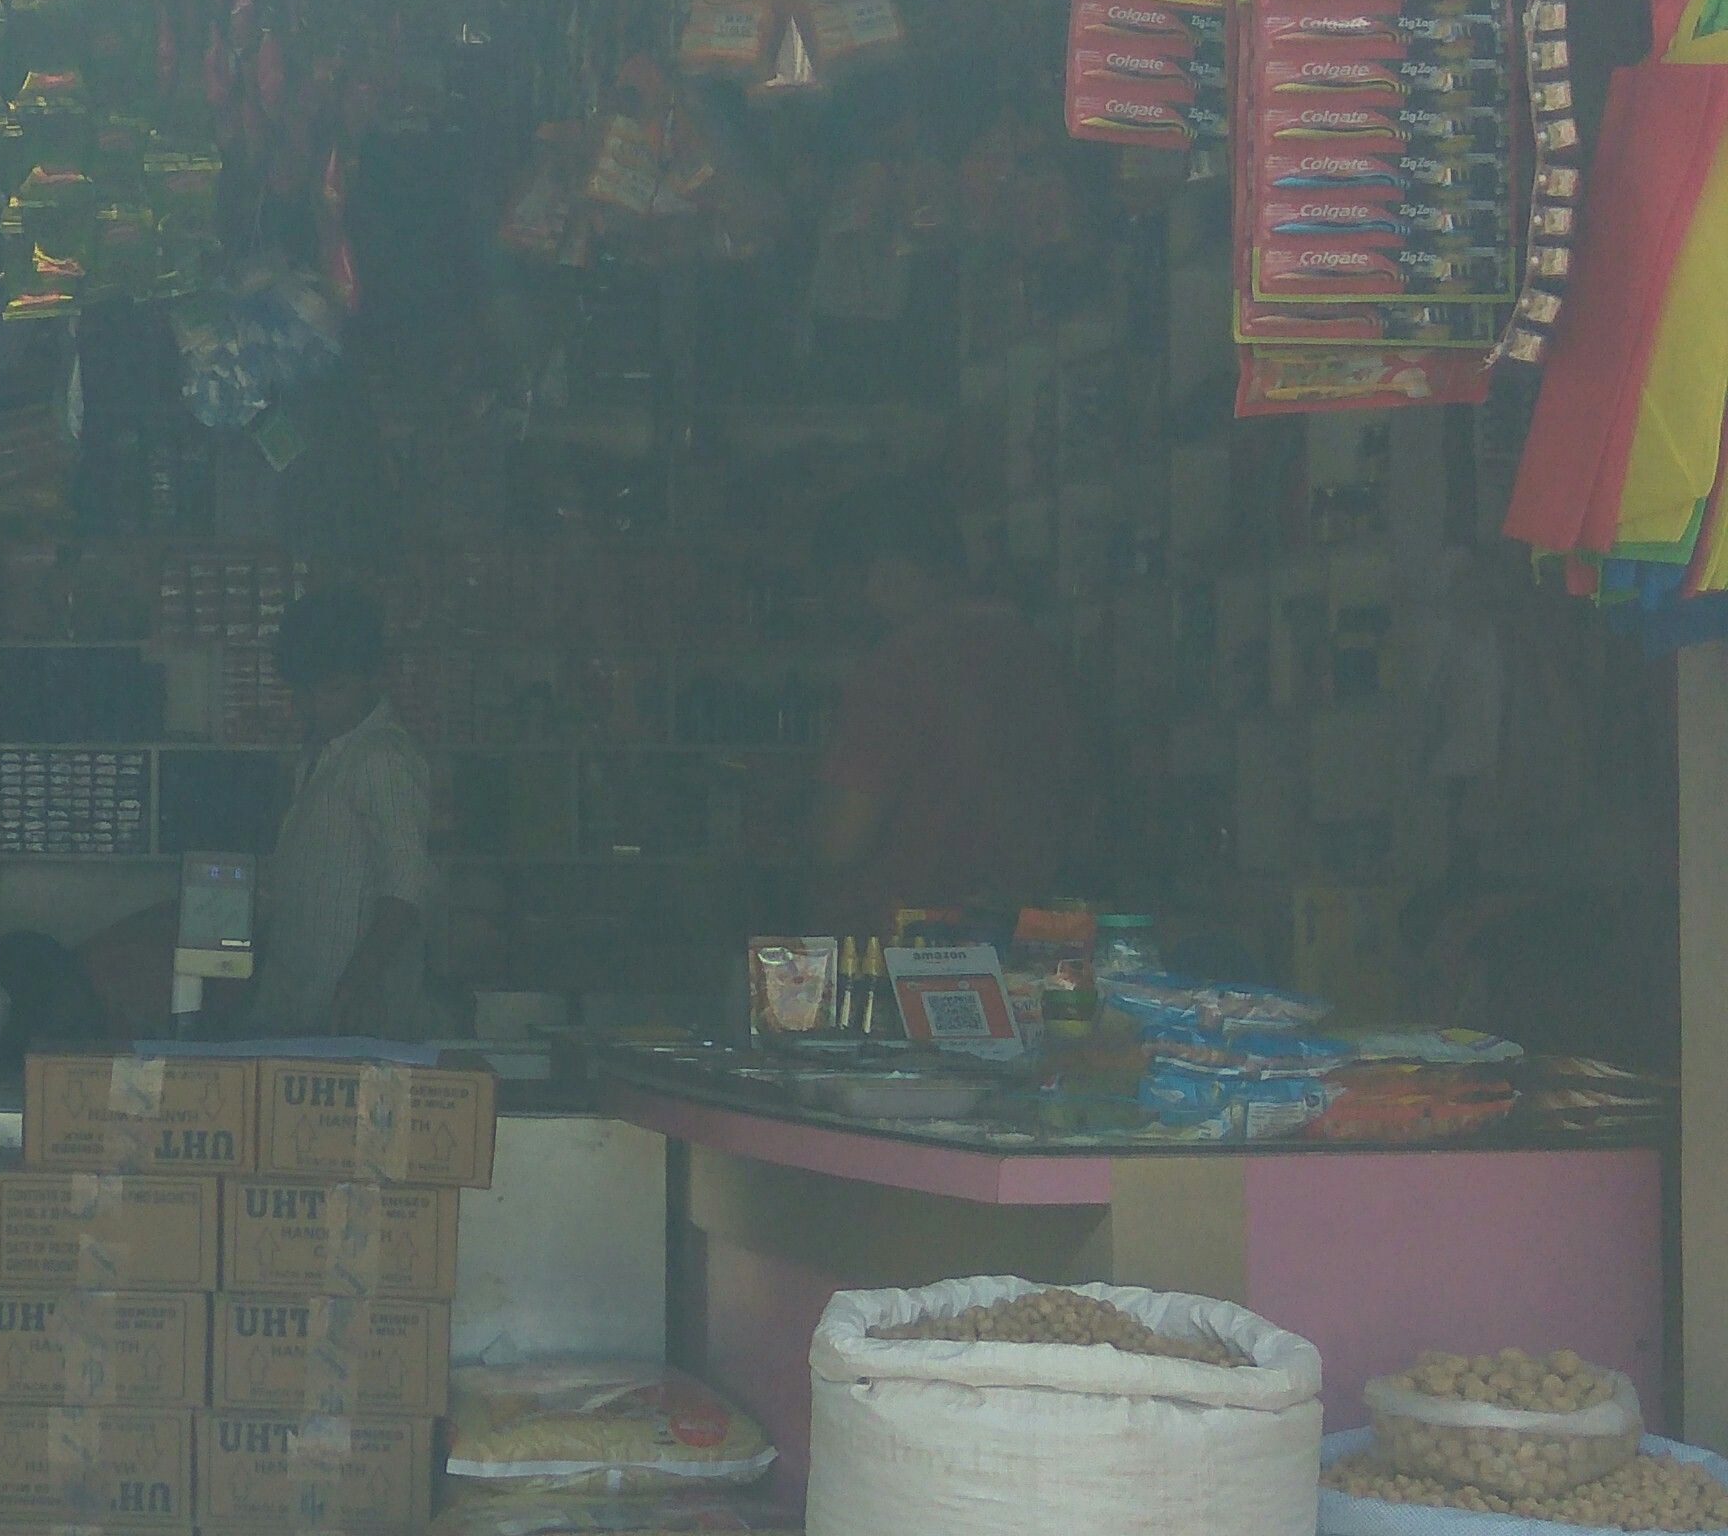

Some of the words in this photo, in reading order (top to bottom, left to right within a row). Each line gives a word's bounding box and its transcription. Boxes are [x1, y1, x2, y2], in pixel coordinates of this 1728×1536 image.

[1107, 5, 1166, 25] Colgate
[1106, 52, 1165, 72] Colgate
[1300, 62, 1370, 79] Colgate
[1105, 99, 1165, 119] Colgate
[1300, 109, 1369, 126] Colgate
[1300, 156, 1369, 173] Colgate
[1300, 203, 1369, 220] Colgate
[1300, 250, 1369, 267] Colgate
[912, 949, 967, 962] amazon
[284, 1075, 360, 1108] UHT
[154, 1128, 236, 1162] UHT
[244, 1187, 325, 1220] UHT
[235, 1305, 310, 1338] UHT
[219, 1421, 300, 1454] UHT
[110, 1480, 171, 1512] UH
